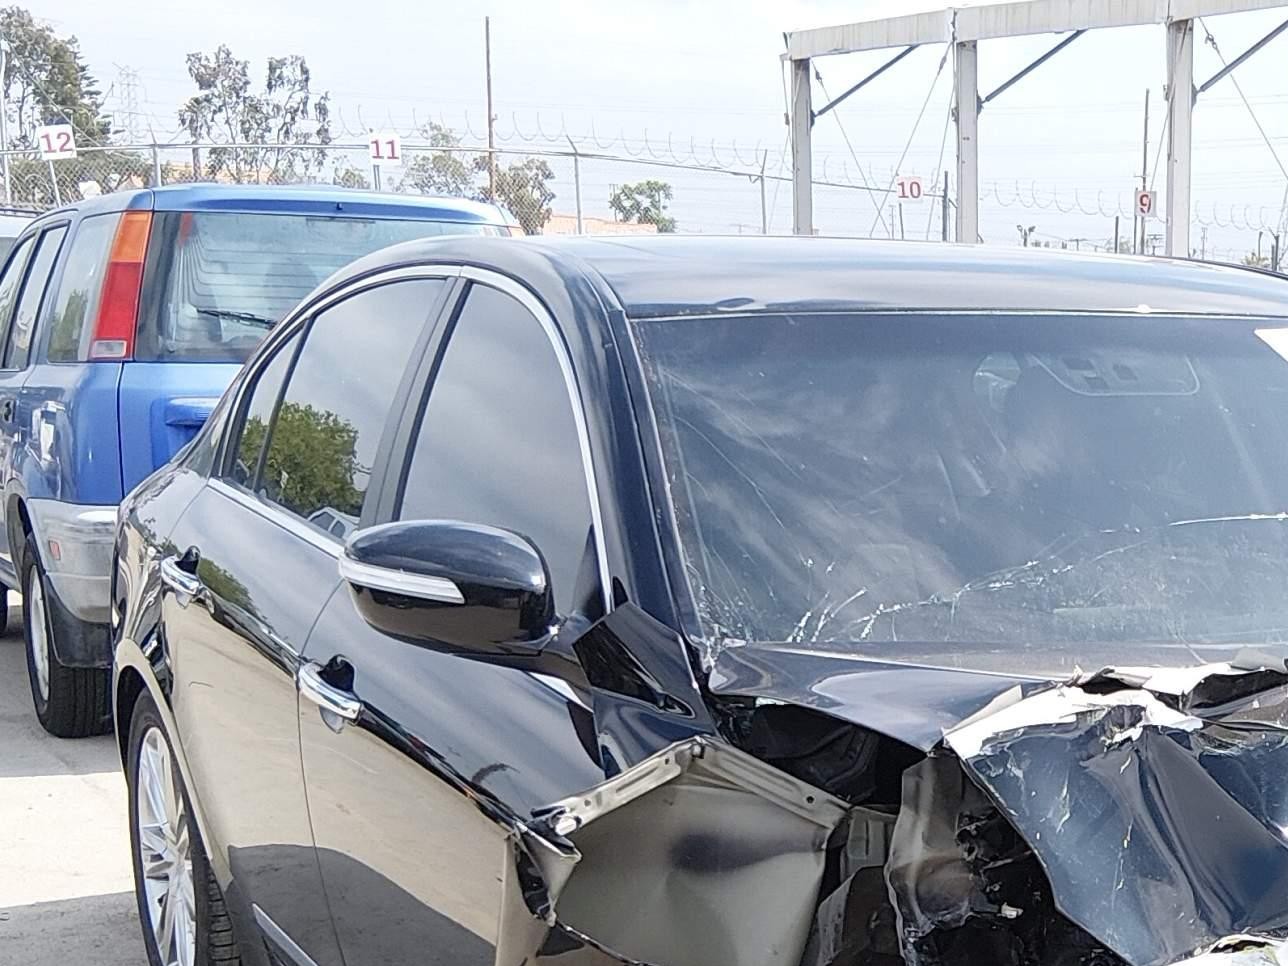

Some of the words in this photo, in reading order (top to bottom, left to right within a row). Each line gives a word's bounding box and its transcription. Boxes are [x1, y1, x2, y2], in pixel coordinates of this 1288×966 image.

[40, 131, 73, 154] 12
[371, 139, 401, 160] 11
[897, 181, 922, 199] 10
[1139, 192, 1152, 214] 9
